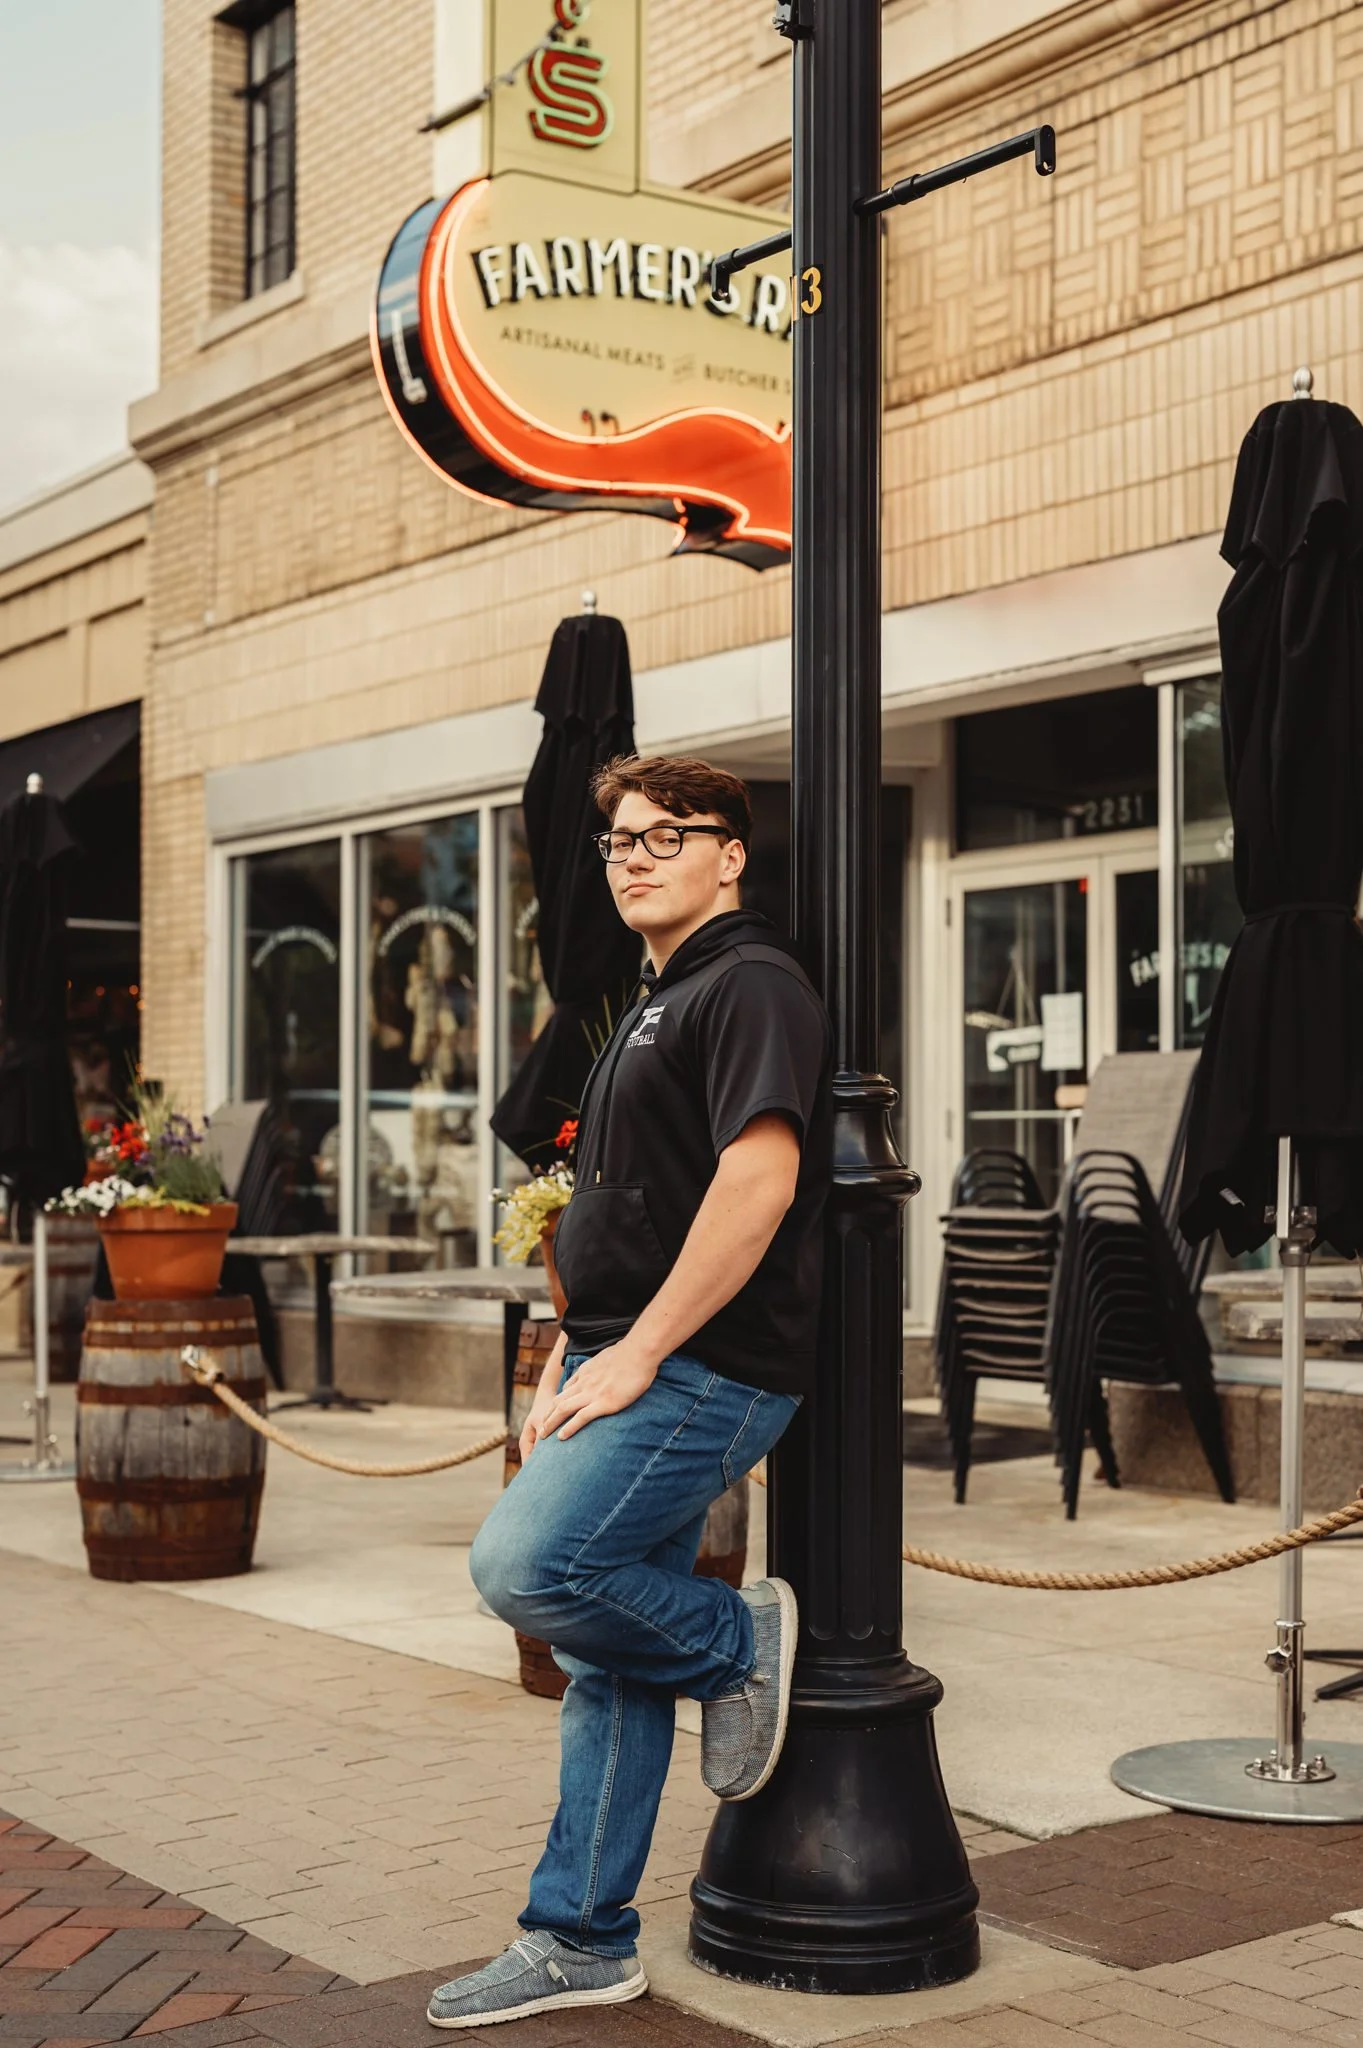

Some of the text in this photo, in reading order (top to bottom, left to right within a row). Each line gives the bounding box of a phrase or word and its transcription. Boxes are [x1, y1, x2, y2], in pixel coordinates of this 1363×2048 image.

[752, 273, 793, 342] R
[500, 325, 601, 360] ARTISANAL
[607, 346, 665, 370] MEATS
[703, 363, 779, 392] BUTCHER
